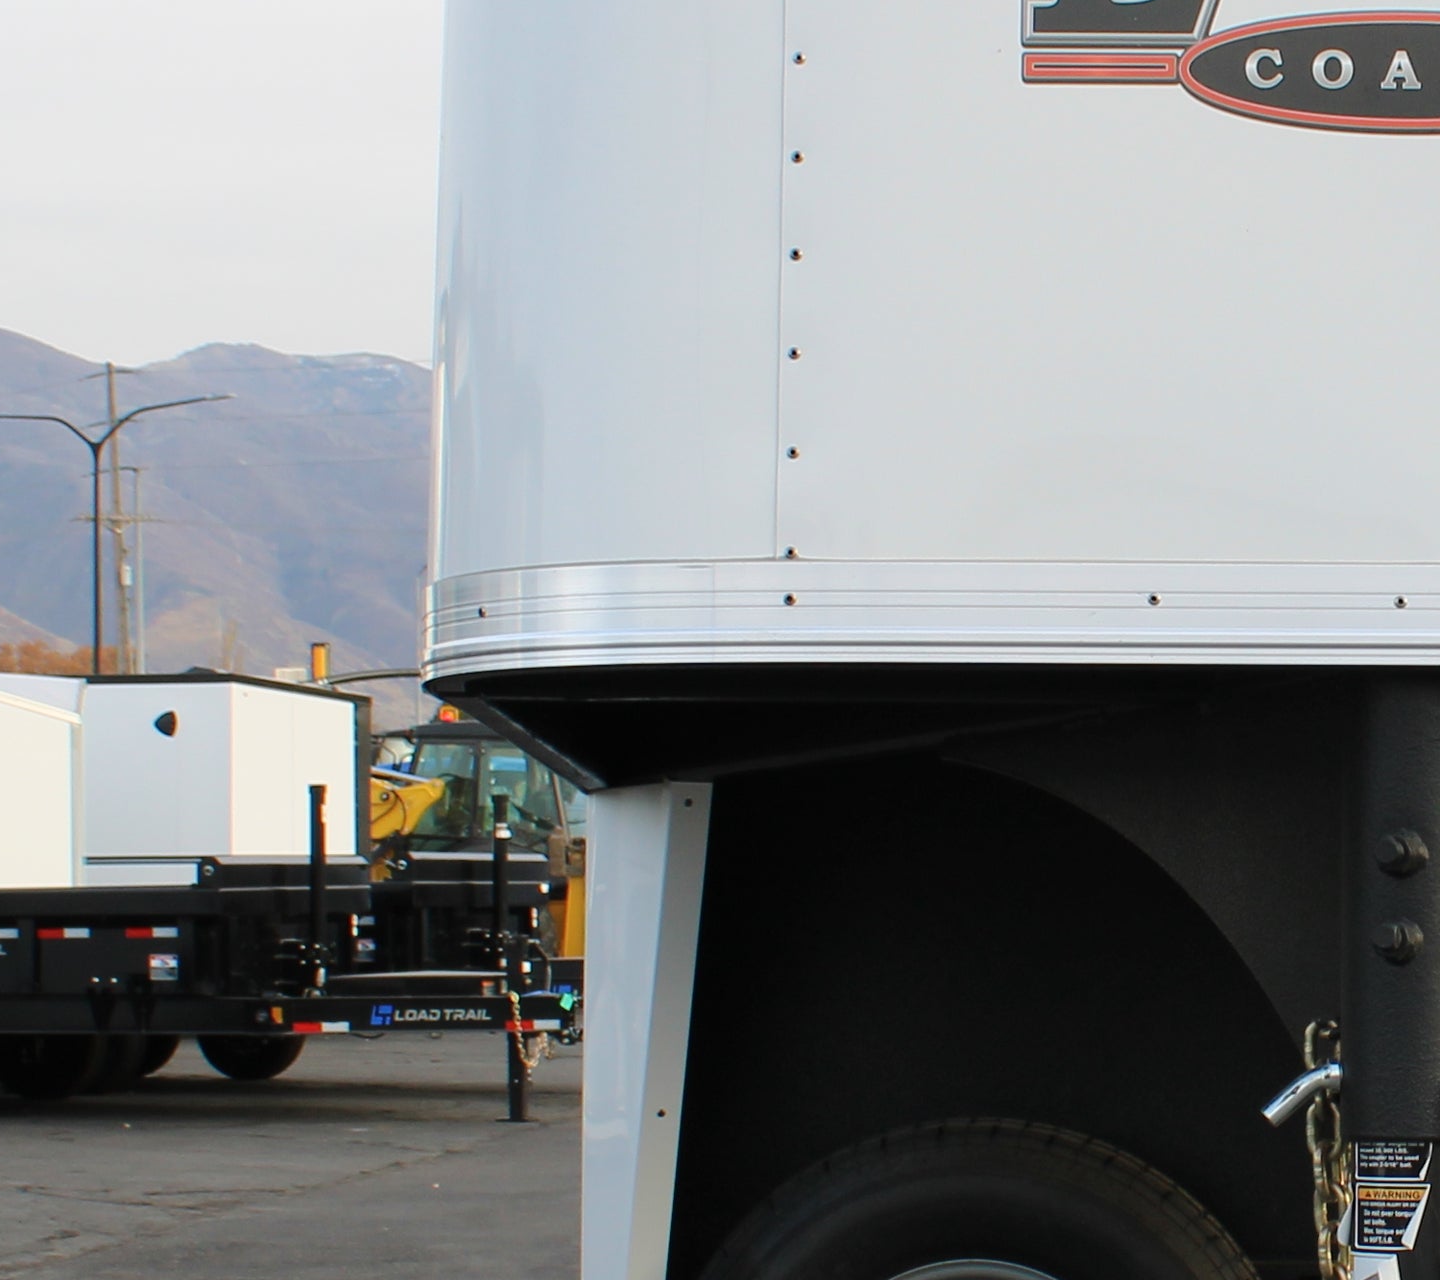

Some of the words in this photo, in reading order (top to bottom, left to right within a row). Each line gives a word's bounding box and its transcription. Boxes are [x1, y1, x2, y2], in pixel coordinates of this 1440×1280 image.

[394, 1009, 441, 1022] LOAD
[443, 1008, 492, 1021] TRAIL
[1372, 1190, 1421, 1200] WARNING
